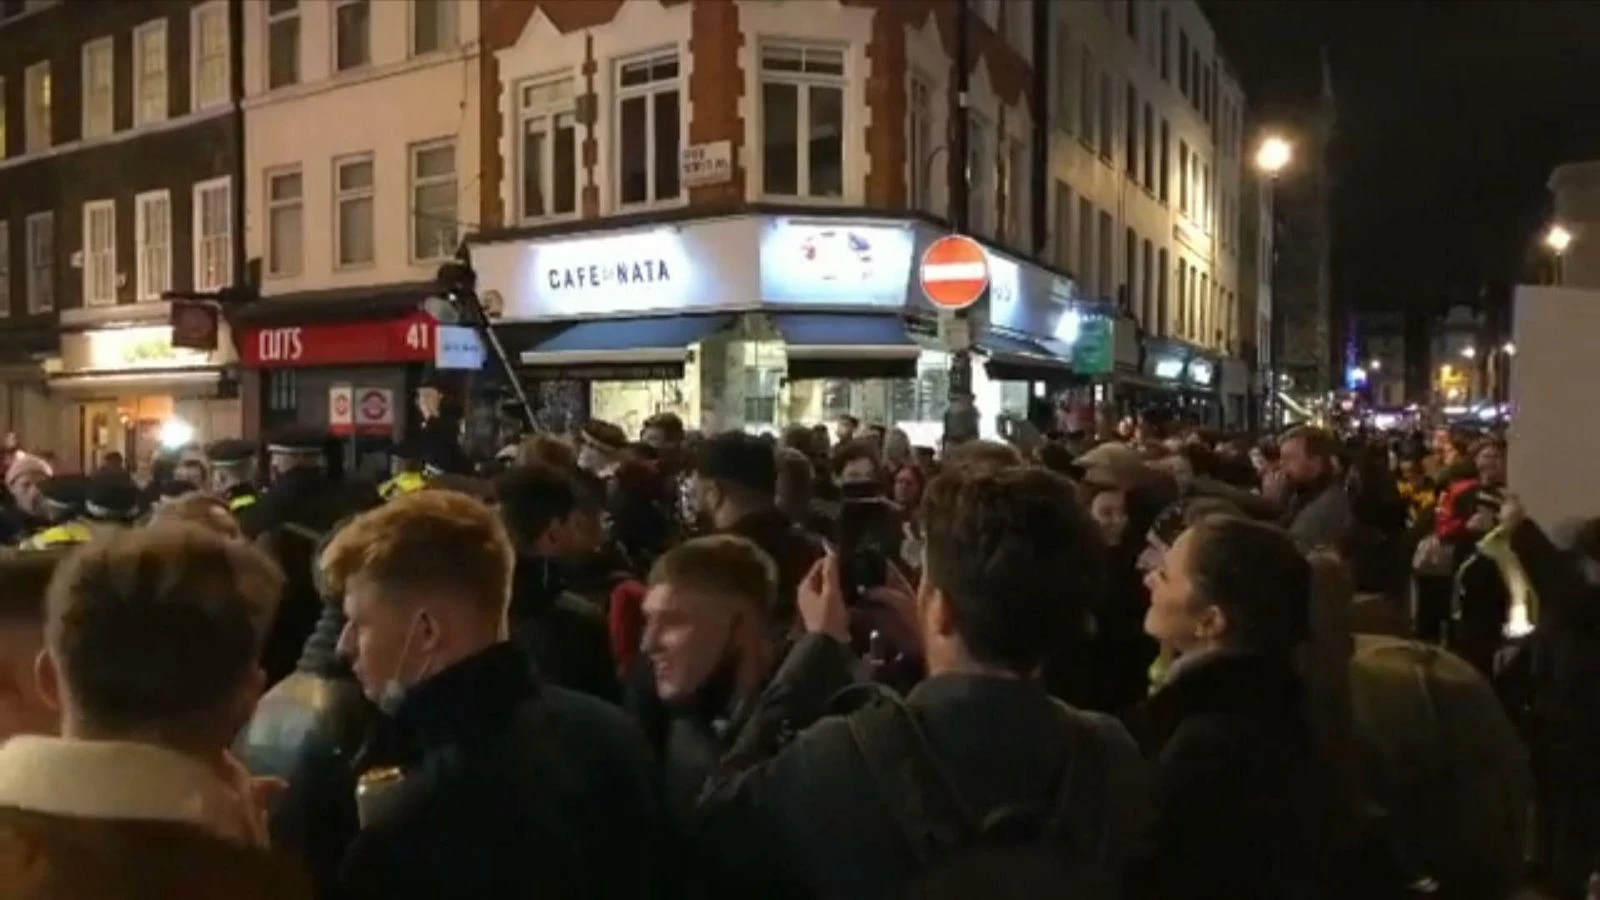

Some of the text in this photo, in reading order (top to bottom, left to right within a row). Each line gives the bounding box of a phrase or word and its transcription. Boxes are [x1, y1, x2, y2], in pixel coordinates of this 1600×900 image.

[548, 264, 600, 289] CAFE
[616, 258, 670, 284] NATA
[259, 327, 303, 360] CUTS
[406, 322, 429, 350] 41
